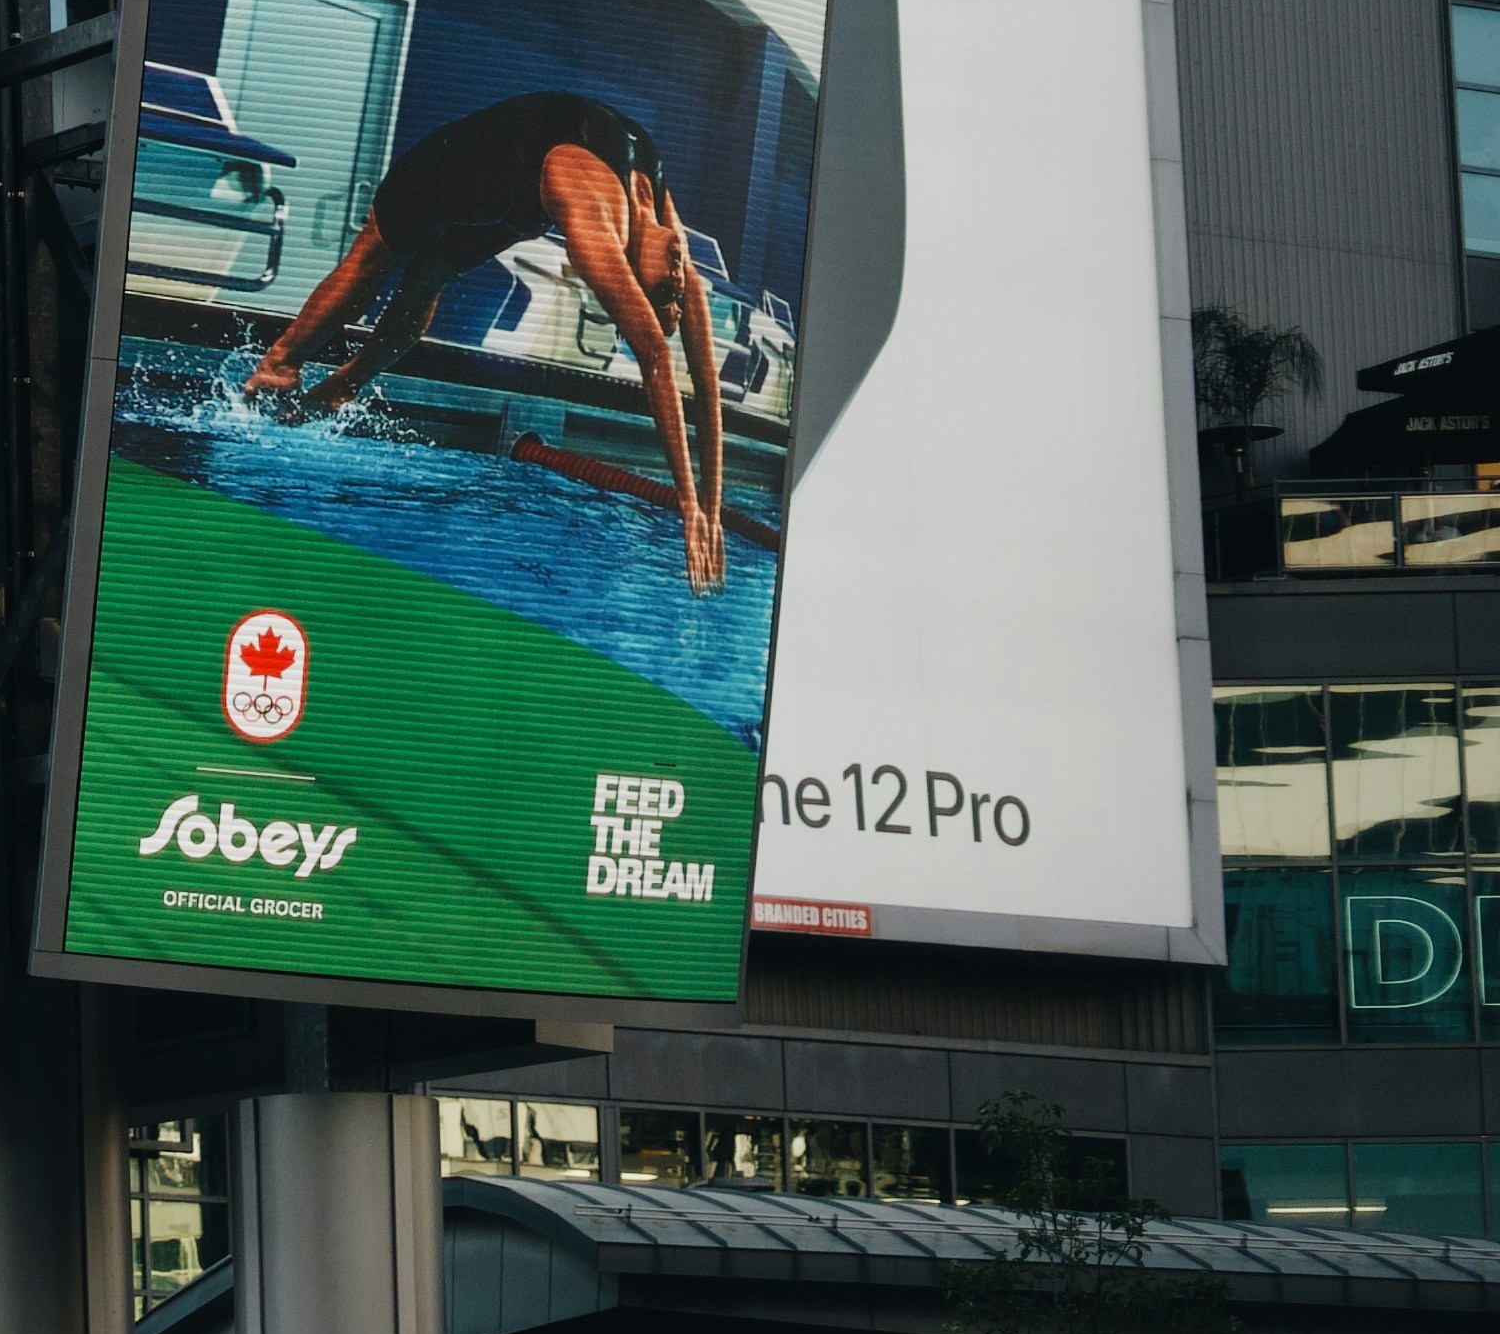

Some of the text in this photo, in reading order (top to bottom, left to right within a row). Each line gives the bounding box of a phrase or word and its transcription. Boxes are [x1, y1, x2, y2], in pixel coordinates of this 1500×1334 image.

[1393, 359, 1416, 375] JACK
[1406, 418, 1436, 431] JACK
[592, 774, 686, 819] FEED
[842, 763, 912, 835] 12
[926, 770, 1031, 847] Pro
[138, 793, 357, 877] Sobeys
[589, 814, 662, 860] THE
[585, 855, 715, 903] DREAM
[162, 887, 325, 920] OFFICIAL GROCER
[754, 901, 868, 931] BRANDED CITIES
